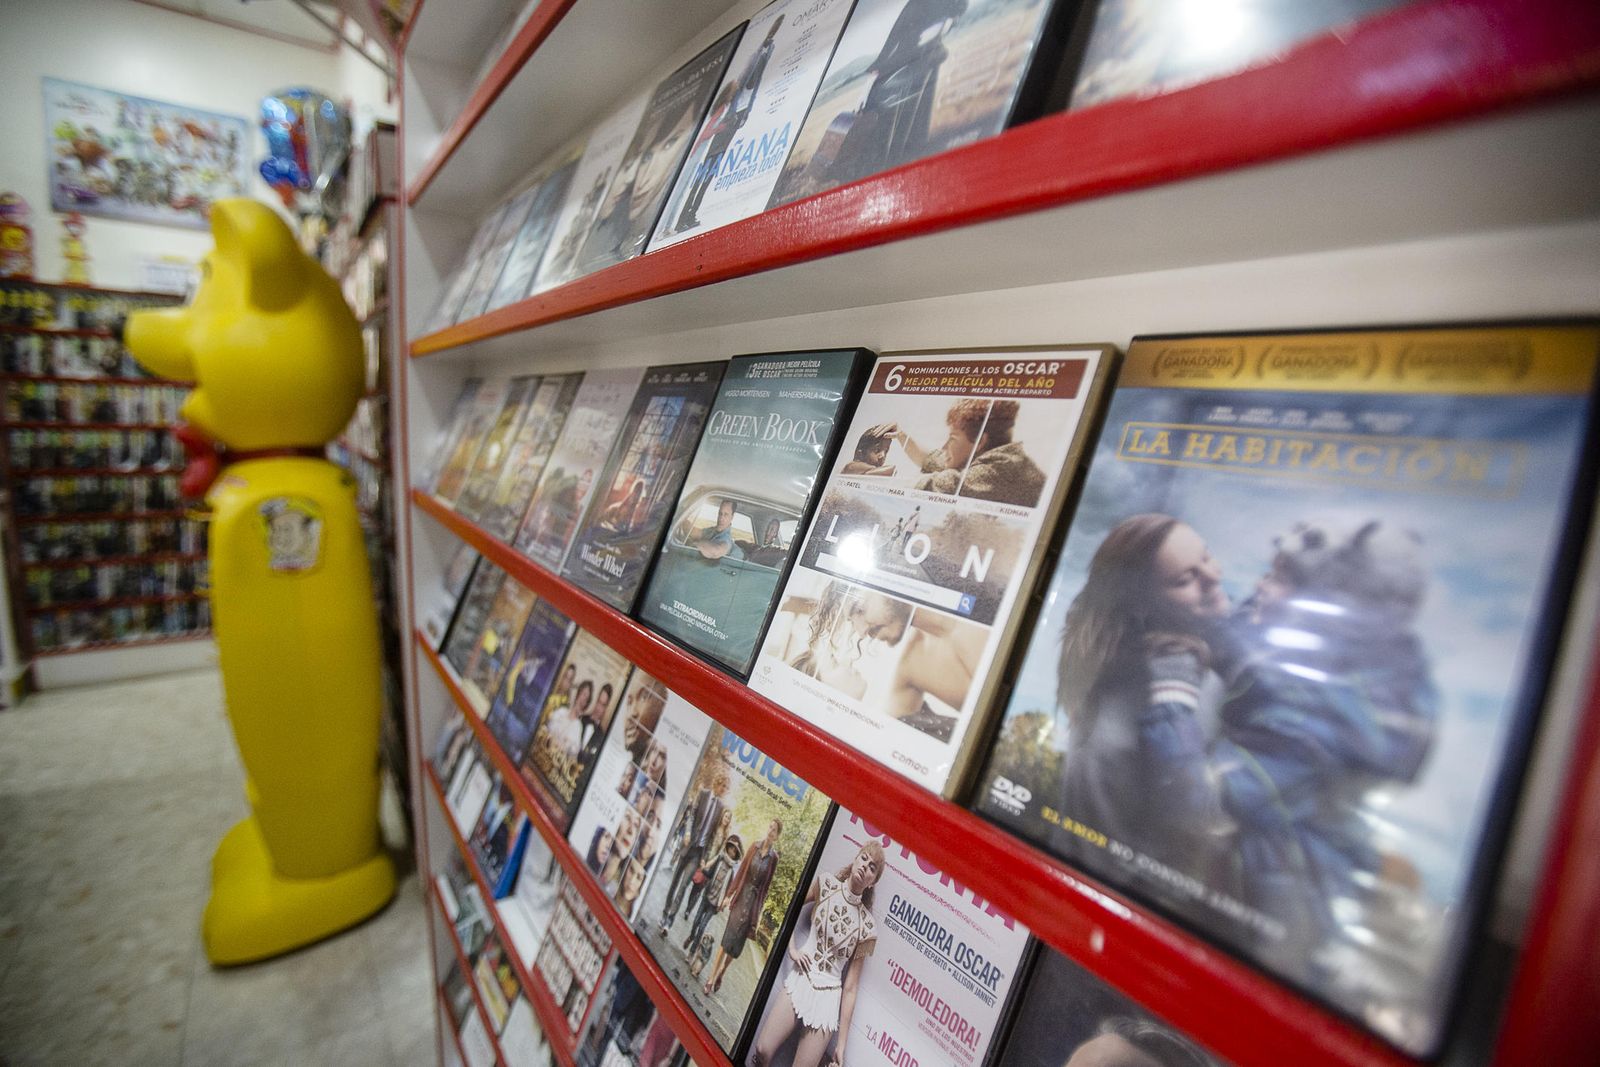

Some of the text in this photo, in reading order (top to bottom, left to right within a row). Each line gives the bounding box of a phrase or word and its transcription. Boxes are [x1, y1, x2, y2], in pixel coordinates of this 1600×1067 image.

[689, 121, 793, 190] MAÑANA
[713, 150, 784, 192] empieza todo
[884, 364, 906, 391] 6
[904, 376, 1056, 388] MEJOR PELÍCULA DEL AÑO
[908, 366, 971, 374] NOMINACIONES
[972, 366, 980, 374] A
[981, 366, 1000, 374] LOS
[708, 410, 825, 445] GREEN BOOK
[1127, 430, 1492, 481] LA HABITACIÓN
[602, 553, 627, 578] Wheel
[992, 775, 1032, 803] DVD
[1041, 806, 1061, 825] EL
[1062, 817, 1108, 849] AMOR
[1108, 840, 1134, 861] NO
[889, 894, 954, 957] GANADORA
[883, 916, 997, 1009] MEJOR ACTRIZ DE REPARTO ALLISON JANNEY
